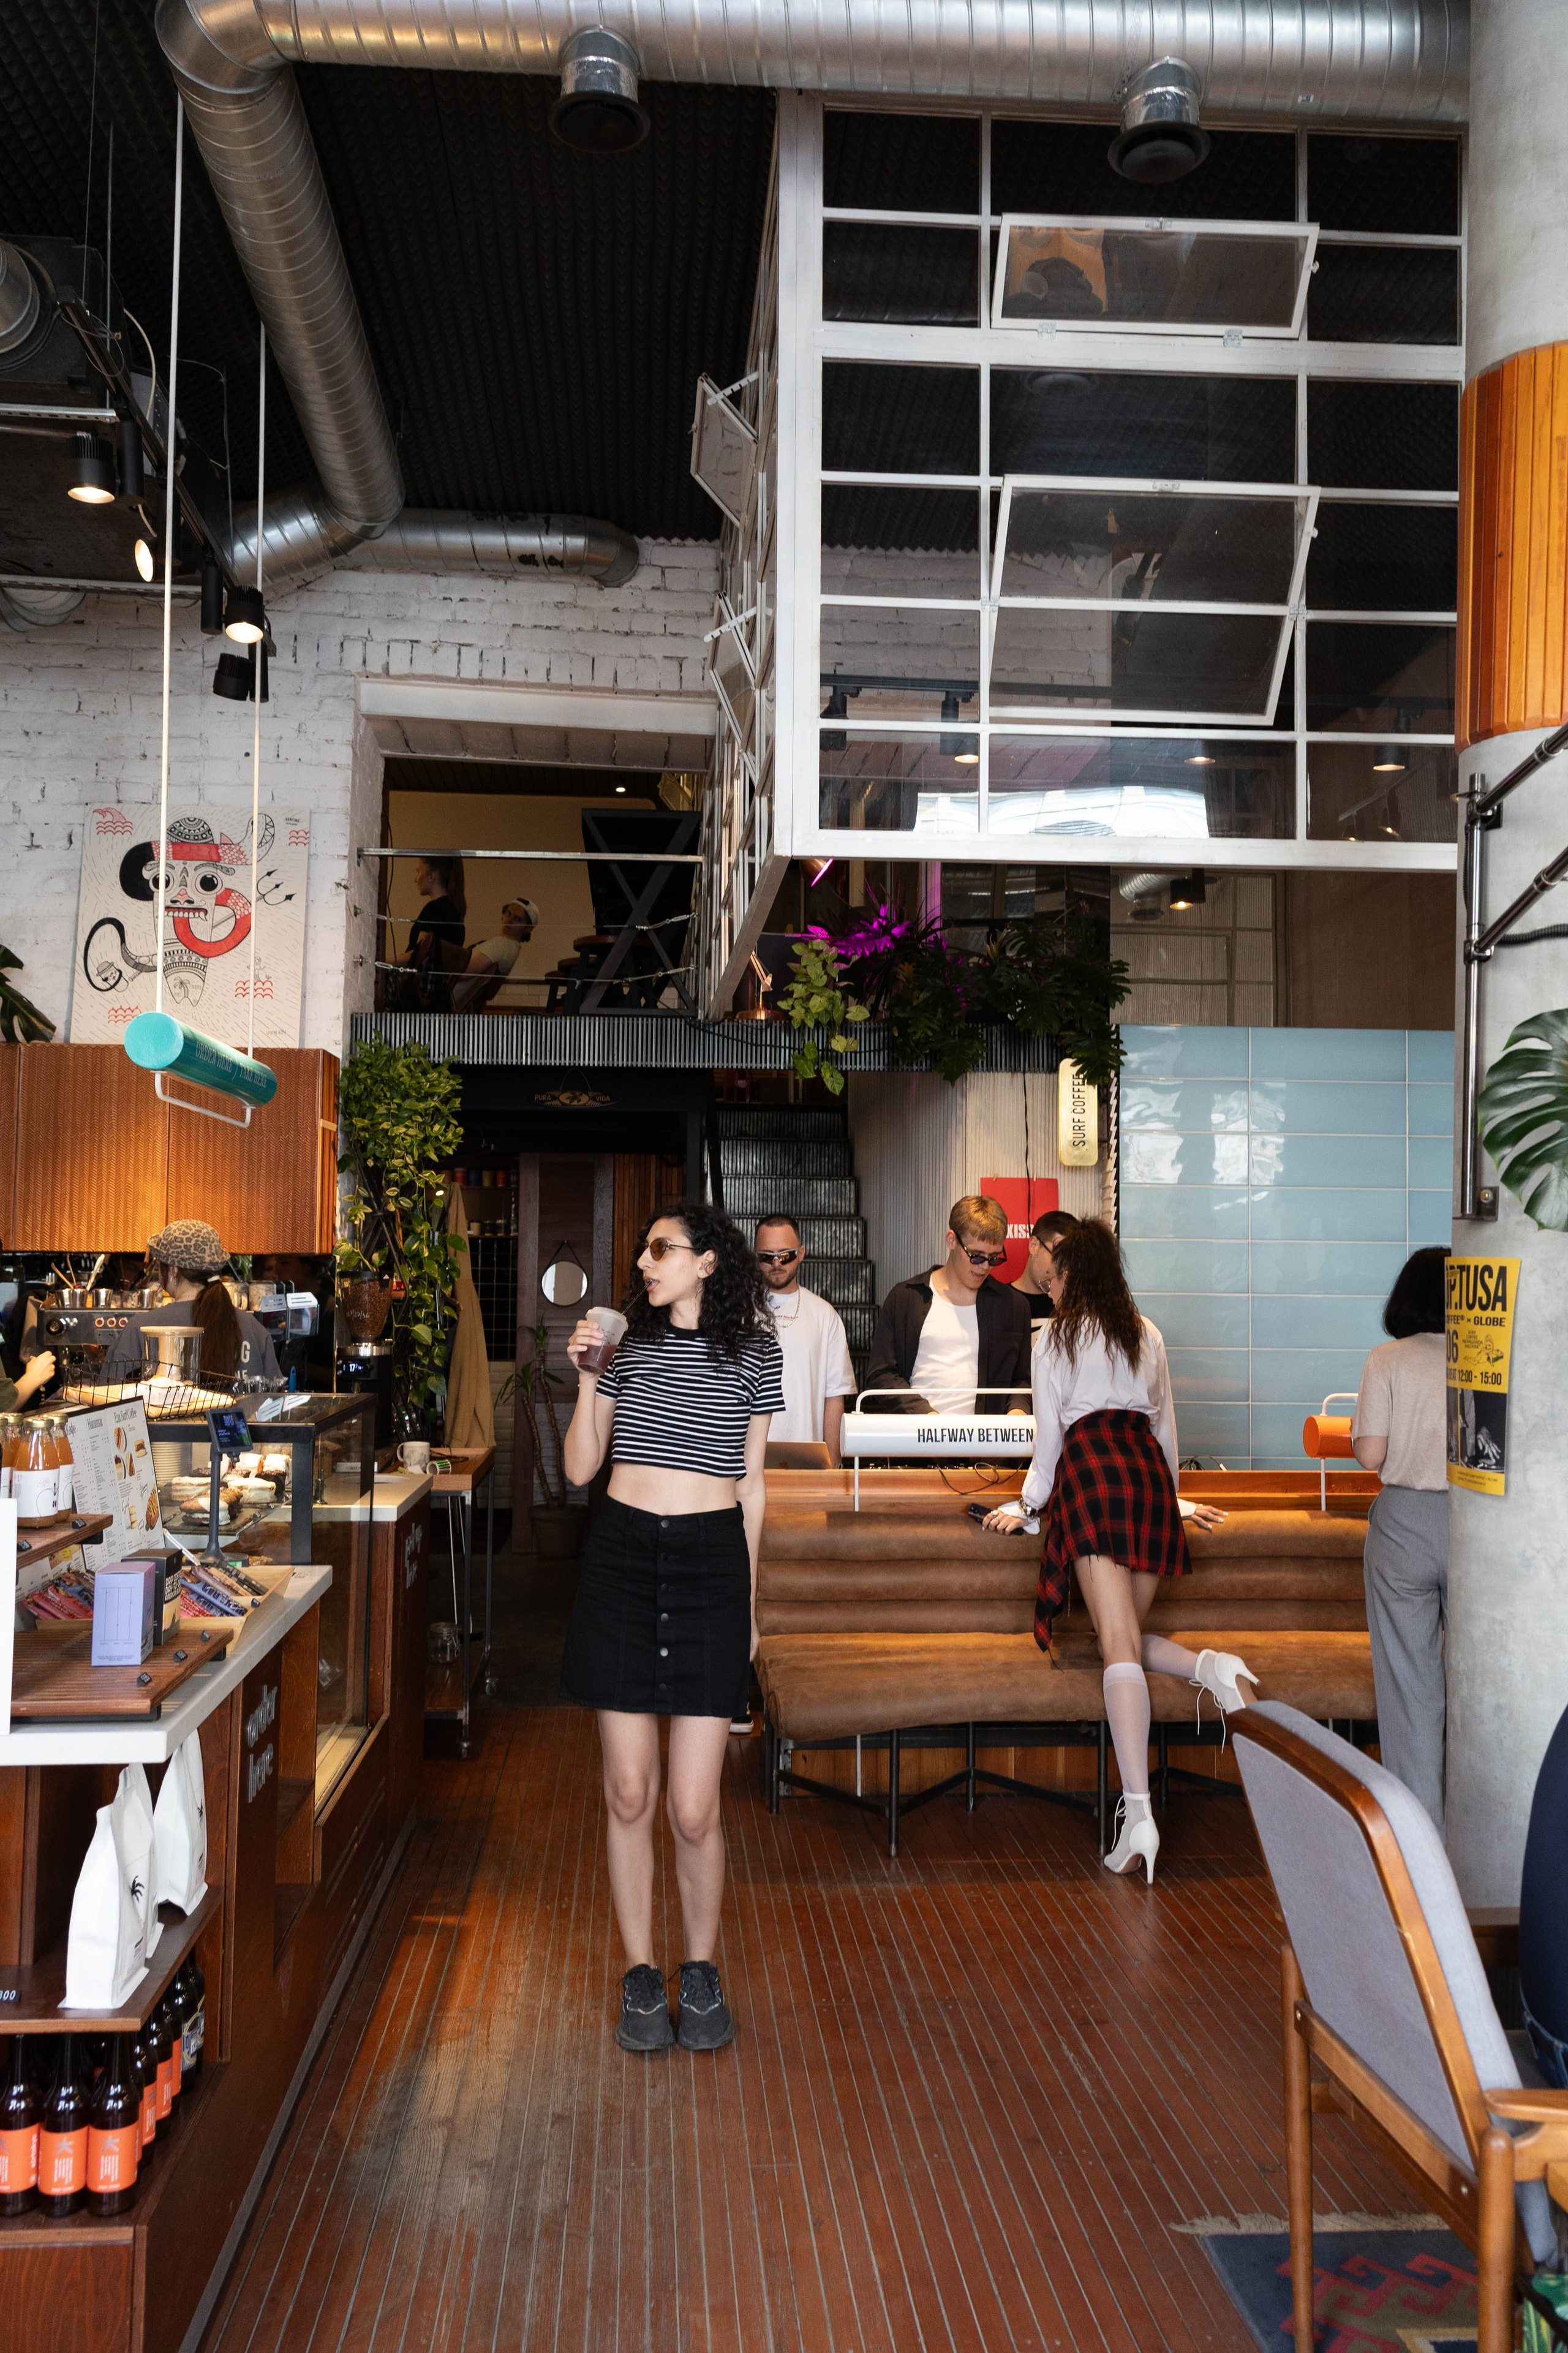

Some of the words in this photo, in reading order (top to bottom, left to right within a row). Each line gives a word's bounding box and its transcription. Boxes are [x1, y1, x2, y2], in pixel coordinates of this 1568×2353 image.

[195, 1041, 217, 1065] ORDER
[217, 1052, 233, 1073] HERE
[239, 1062, 254, 1082] TAKE
[253, 1070, 267, 1088] HERE
[1072, 1118, 1085, 1147] SURF
[1474, 1316, 1506, 1327] GLOBE
[1458, 1369, 1472, 1383] 12:00
[1480, 1371, 1502, 1385] 15:00
[918, 1429, 974, 1443] HALFWAY
[978, 1429, 1033, 1443] BETWEEN
[248, 1743, 273, 1803] here
